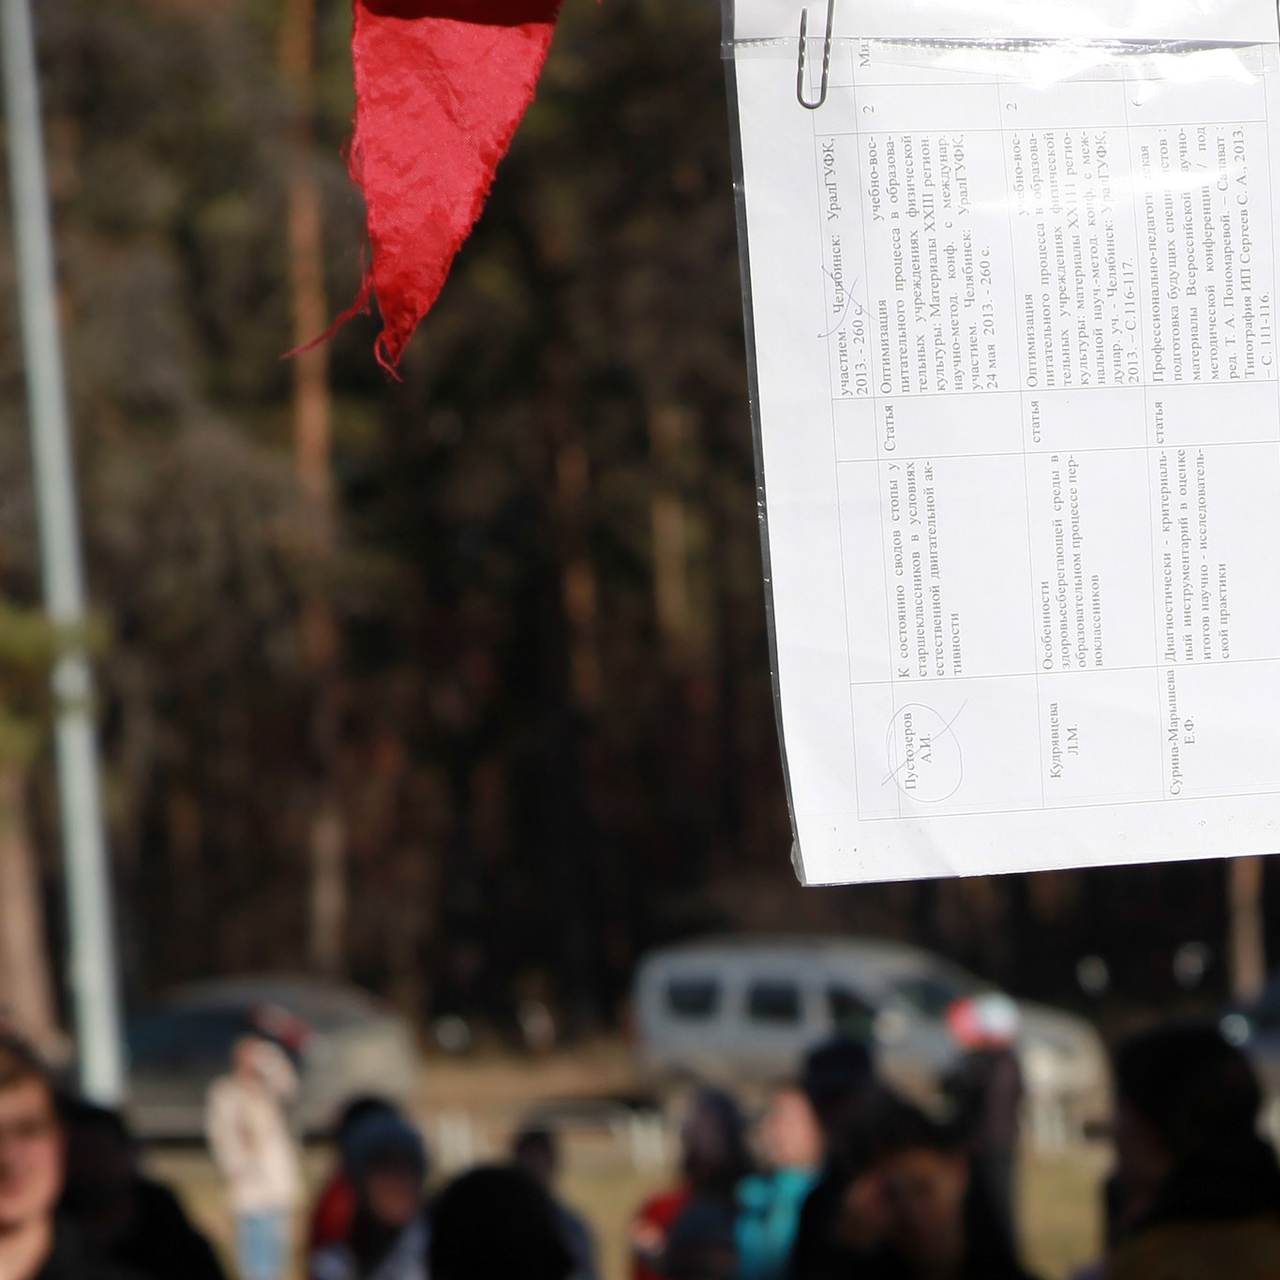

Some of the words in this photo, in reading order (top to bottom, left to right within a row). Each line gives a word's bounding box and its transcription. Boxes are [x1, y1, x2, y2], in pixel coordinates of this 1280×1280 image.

[862, 105, 874, 114] 2
[1006, 103, 1017, 111] 2
[885, 135, 901, 204] образова-
[921, 135, 936, 188] регион.
[1029, 132, 1044, 199] образова-
[1064, 132, 1078, 176] регио-
[1080, 131, 1091, 165] меж-
[1178, 128, 1192, 172] аучно-
[1197, 126, 1207, 151] под
[1232, 126, 1245, 162] 2013.
[822, 138, 842, 221] УралГУФК,
[867, 136, 885, 221] учебно-вос-
[903, 135, 920, 218] физической
[938, 135, 952, 209] междунар.
[952, 134, 972, 216] УралГУФК,
[1043, 132, 1063, 214] физической
[1159, 139, 1175, 233] специстов
[1235, 166, 1248, 186] А.,
[1236, 191, 1248, 205] С.
[891, 211, 899, 219] в
[1083, 188, 1097, 226] конф.
[1239, 209, 1253, 264] Сергеев
[831, 235, 847, 314] Челябинск:
[892, 227, 907, 291] процесса
[942, 241, 958, 279] конф.
[961, 229, 975, 308] Челябинск:
[979, 260, 992, 286] 260
[981, 246, 990, 257] с.
[1036, 223, 1052, 285] процесса
[1054, 225, 1071, 317] учреждениях
[1072, 235, 1086, 310] материалы
[1104, 220, 1118, 298] Челябинск:
[1166, 239, 1181, 300] будущих
[1180, 192, 1199, 296] Всероссийской
[1219, 211, 1235, 307] Пономаревой.
[910, 230, 927, 323] учреждениях
[928, 238, 942, 318] Материалы
[1089, 234, 1105, 320] науч.-метод.
[1122, 258, 1137, 331] С.116-117.
[1240, 268, 1251, 292] ИП
[852, 319, 865, 345] 260
[853, 305, 863, 316] с.
[949, 292, 965, 391] научно-метод.
[982, 299, 995, 336] 2013.
[1025, 294, 1038, 388] Оптимизация
[1042, 293, 1055, 387] питательного
[1111, 314, 1123, 335] уч.
[1204, 285, 1219, 380] методической
[1224, 313, 1235, 329] А.
[1225, 334, 1236, 347] Т.
[1241, 296, 1256, 379] Типография
[1259, 291, 1271, 345] 111-116.
[837, 327, 854, 396] участием.
[878, 299, 893, 394] Оптимизация
[894, 299, 911, 393] питательного
[915, 334, 929, 393] тельных
[932, 323, 948, 391] культуры:
[968, 322, 984, 391] участием.
[987, 344, 997, 369] мая
[1061, 329, 1072, 387] тельных
[1077, 315, 1092, 386] культуры:
[1092, 328, 1106, 385] нальной
[1112, 340, 1125, 385] дунар.
[1126, 347, 1139, 384] 2013.
[1171, 305, 1183, 381] подготовка
[1189, 307, 1202, 381] материалы
[1228, 352, 1240, 379] ред.
[1261, 351, 1272, 366] С.
[854, 358, 868, 396] 2013.
[986, 373, 998, 390] 24
[883, 405, 896, 452] Статья
[1031, 400, 1041, 443] статья
[1155, 402, 1164, 444] статья
[888, 462, 900, 471] у
[905, 461, 921, 525] условиях
[924, 460, 933, 481] ак-
[1052, 470, 1065, 512] среды
[1068, 454, 1079, 483] пер-
[1159, 450, 1173, 532] критериаль-
[1177, 449, 1188, 496] оценке
[889, 480, 901, 522] стопы
[1069, 487, 1083, 549] процессе
[1196, 448, 1208, 550] исследователь-
[893, 530, 904, 576] сводов
[922, 487, 941, 580] двигательной
[1051, 519, 1072, 669] здоровьесберегающей
[1177, 517, 1194, 627] инструментарий
[1200, 564, 1212, 611] научно
[1218, 563, 1231, 625] практики
[896, 585, 910, 659] состоянию
[911, 551, 929, 677] старшеклассников
[928, 585, 945, 676] естественной
[1040, 581, 1054, 670] Особенности
[1072, 553, 1089, 668] образовательном
[1091, 574, 1103, 667] воклассников
[1163, 553, 1178, 662] Диагностически
[1202, 616, 1212, 660] итогов
[898, 667, 910, 678] К
[950, 613, 962, 676] тивности
[1182, 634, 1194, 661] ный
[1218, 629, 1230, 659] ской
[903, 711, 919, 790] Пустозеров
[920, 733, 932, 764] А.И.
[1049, 702, 1064, 778] Кудрявцева
[1066, 724, 1079, 756] Л.М.
[1167, 669, 1183, 795] Сурина-Марышева
[1183, 716, 1195, 744] Е.Ф.
